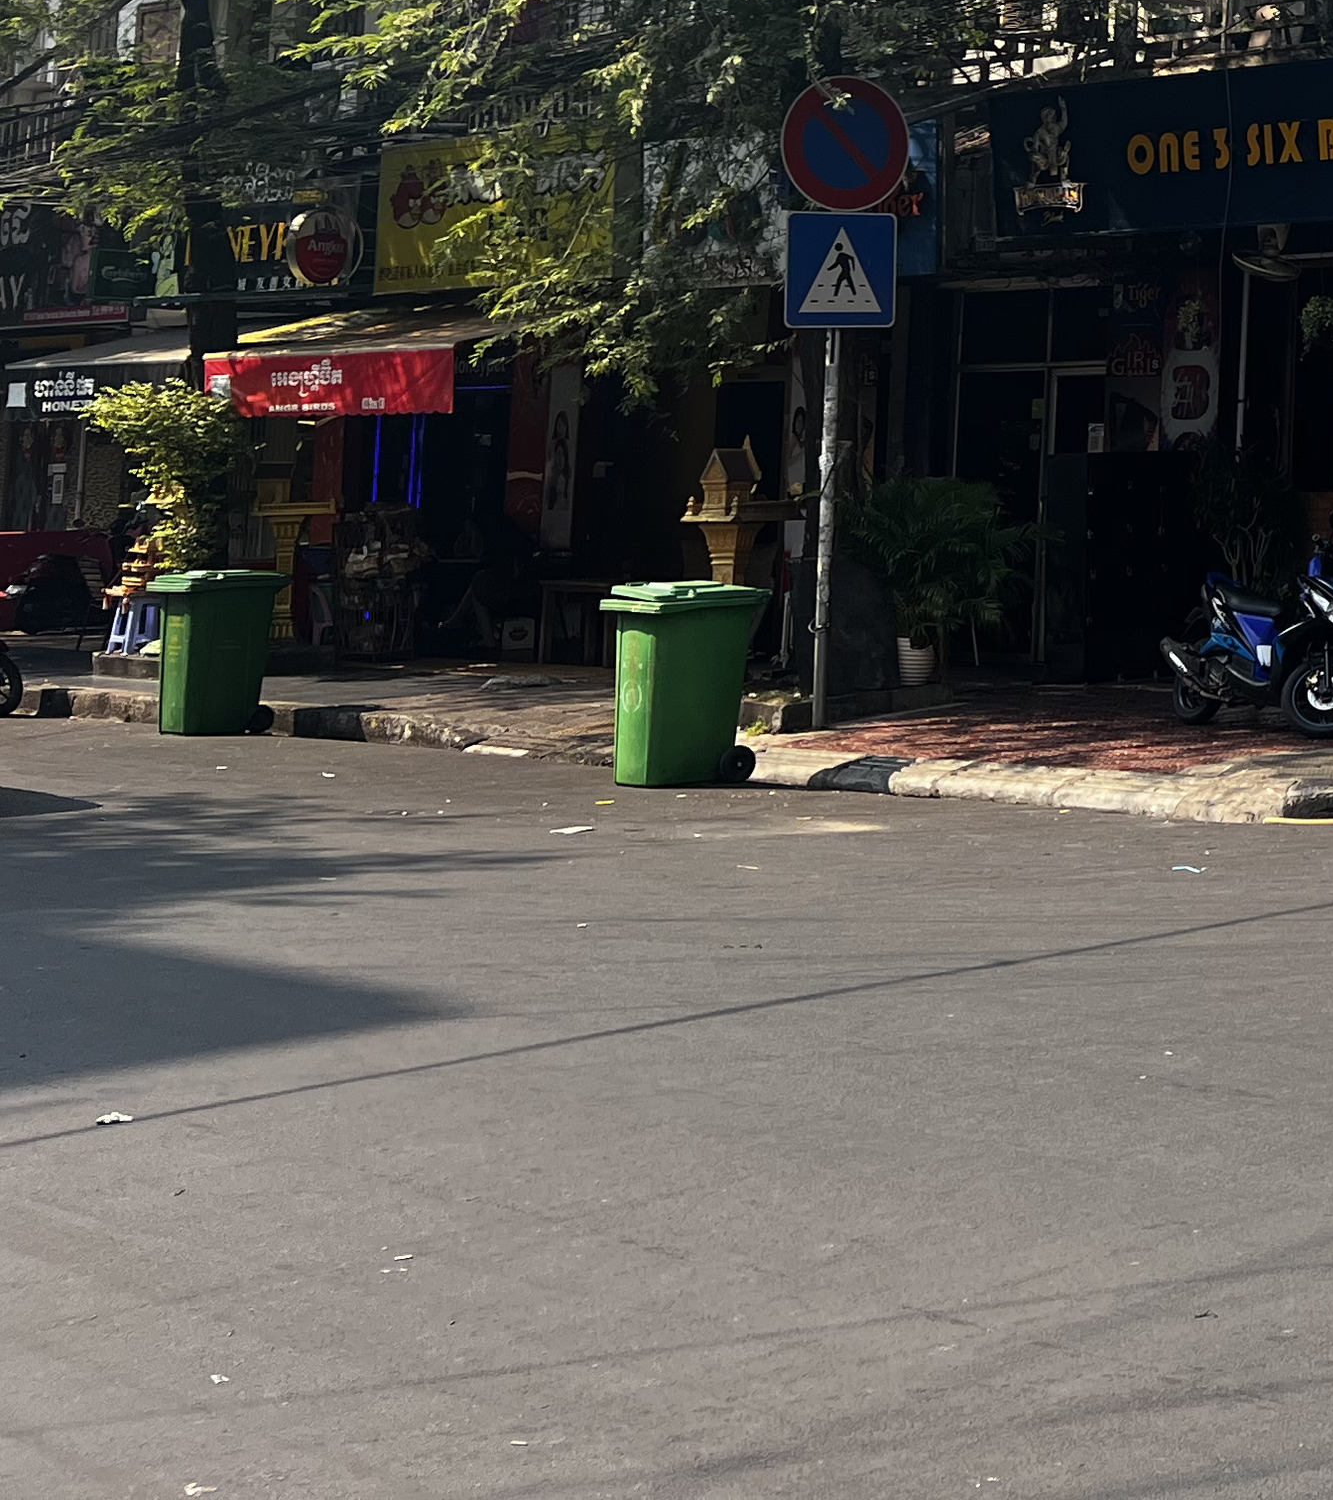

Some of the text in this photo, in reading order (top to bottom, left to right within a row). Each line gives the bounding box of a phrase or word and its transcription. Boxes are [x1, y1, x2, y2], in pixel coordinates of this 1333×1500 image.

[1126, 130, 1202, 176] ONE
[1212, 127, 1231, 170] 3
[1246, 120, 1304, 167] SIX
[1127, 283, 1161, 308] Tiger
